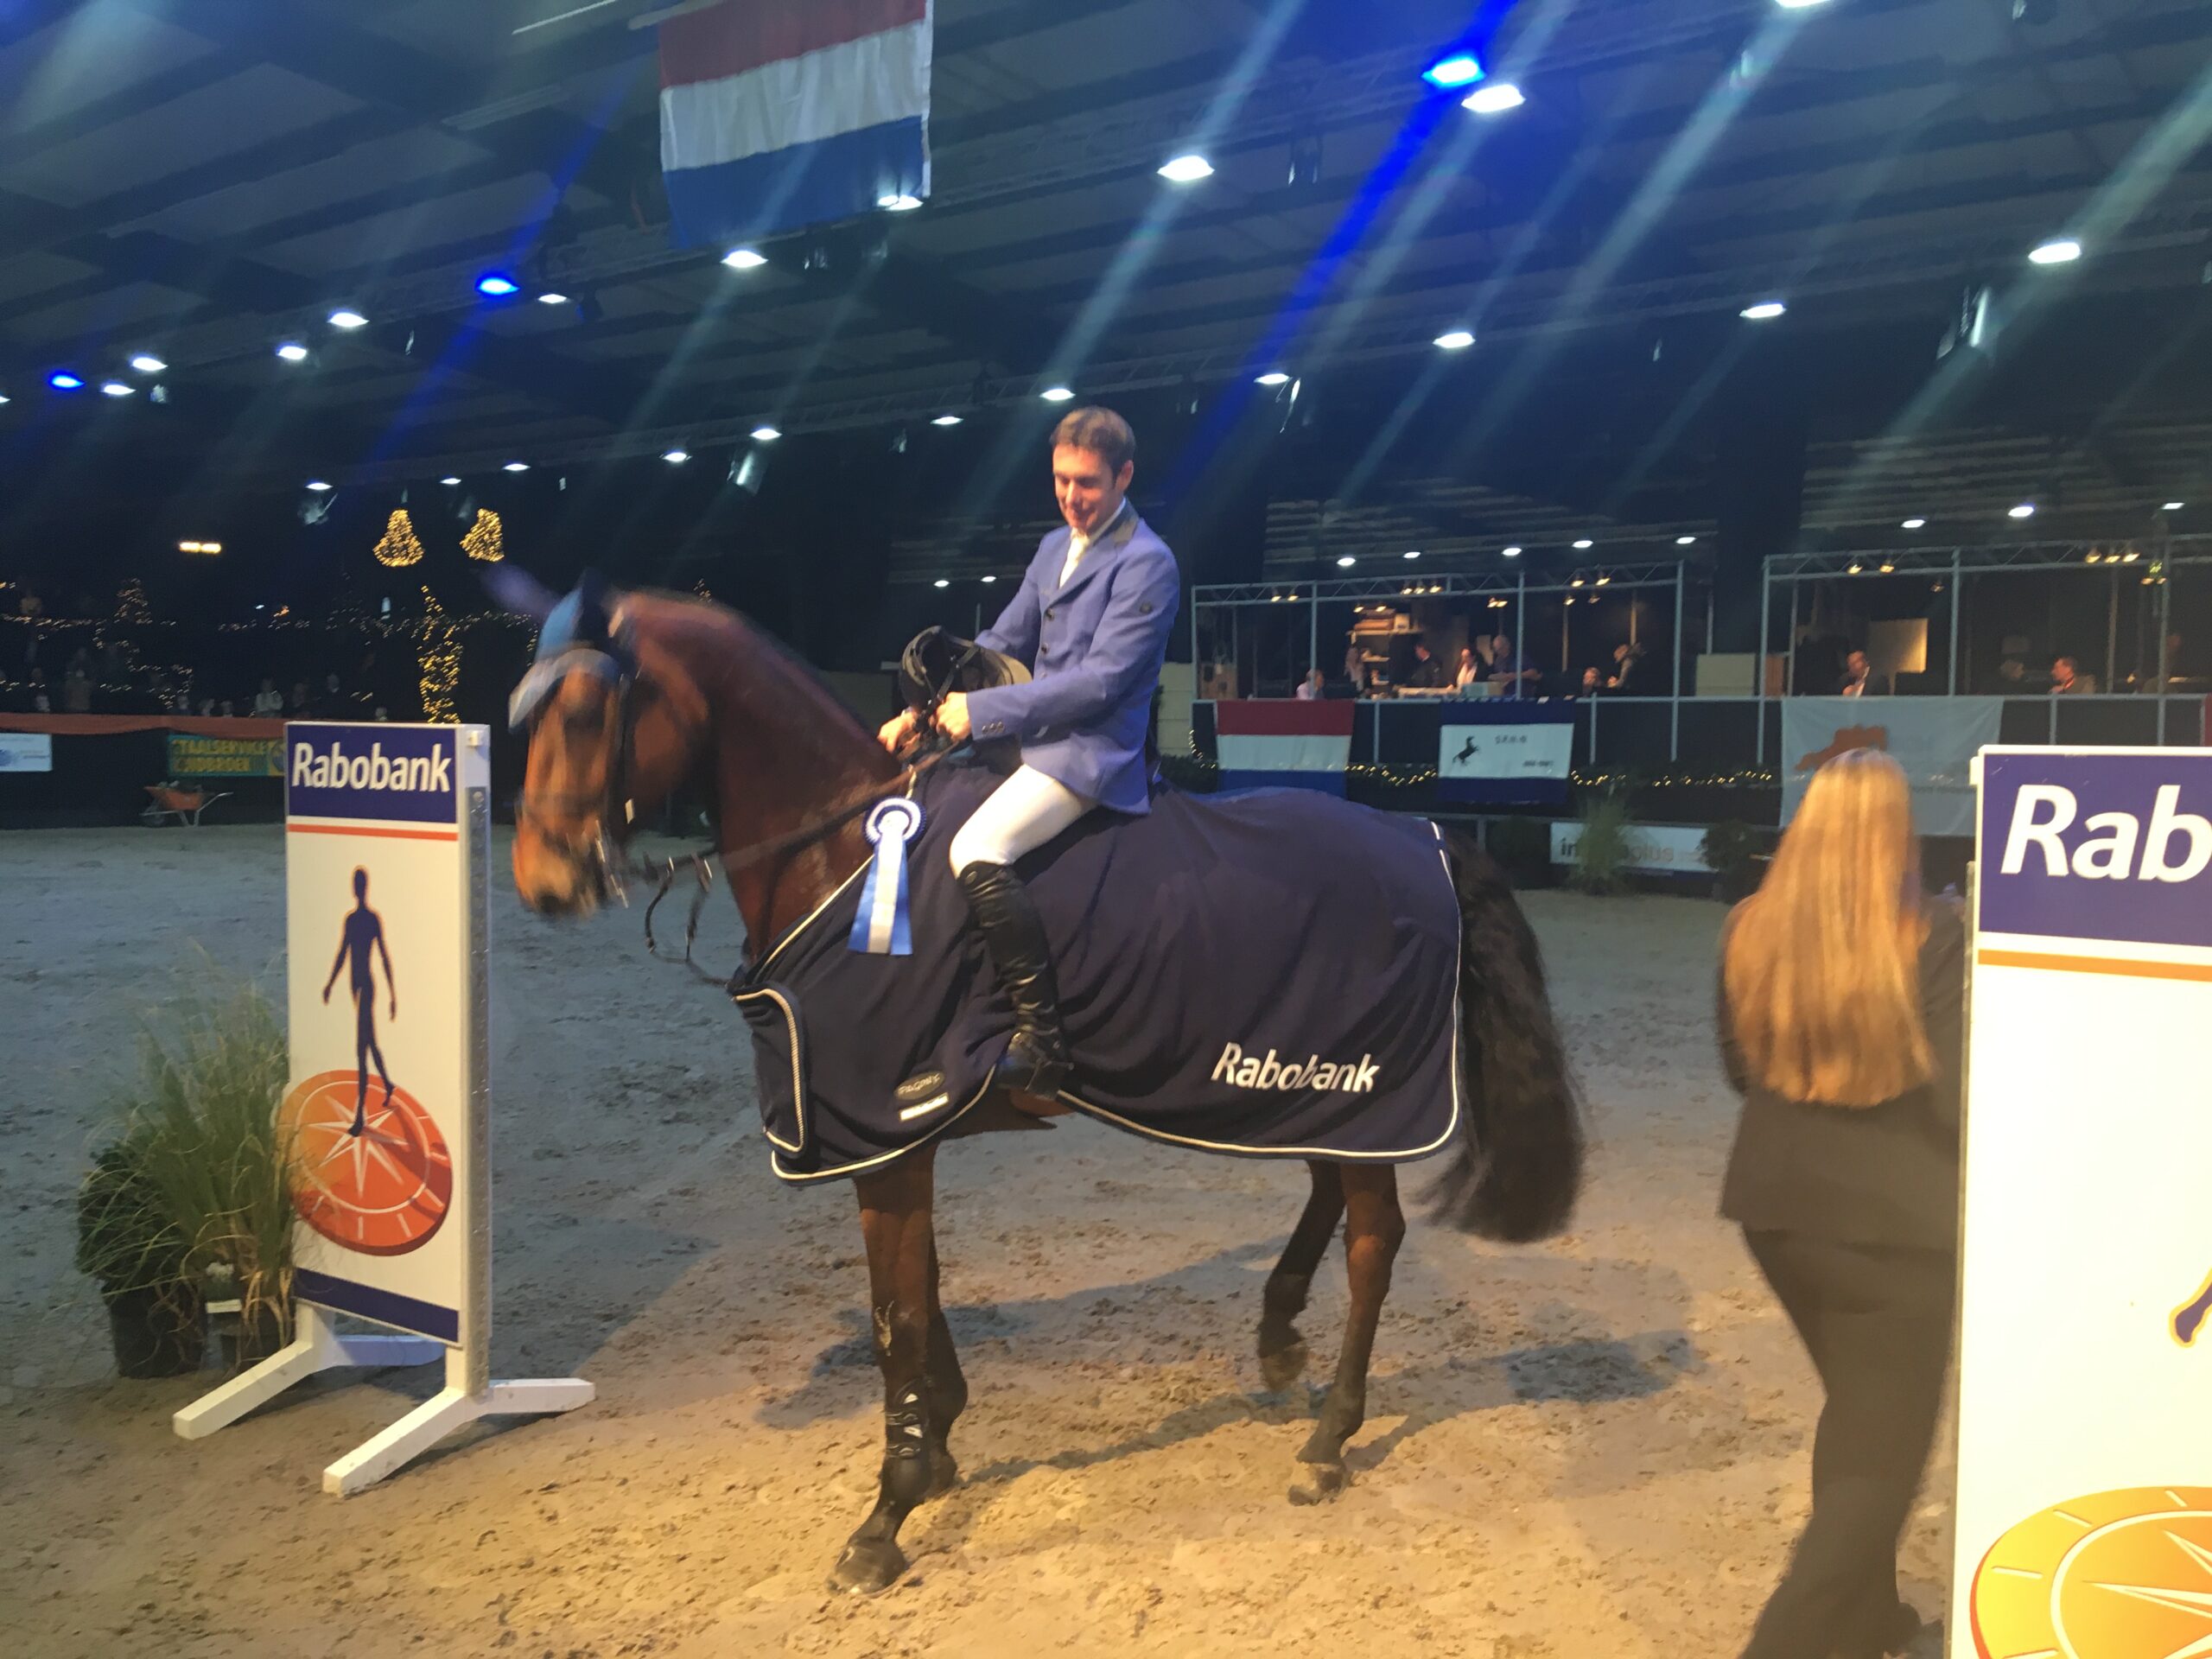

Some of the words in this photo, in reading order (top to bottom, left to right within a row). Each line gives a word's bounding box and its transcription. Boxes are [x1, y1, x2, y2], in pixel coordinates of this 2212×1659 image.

[292, 741, 451, 792] Rabobank
[2000, 784, 2212, 882] Rab
[1211, 1042, 1380, 1092] Rabobank
